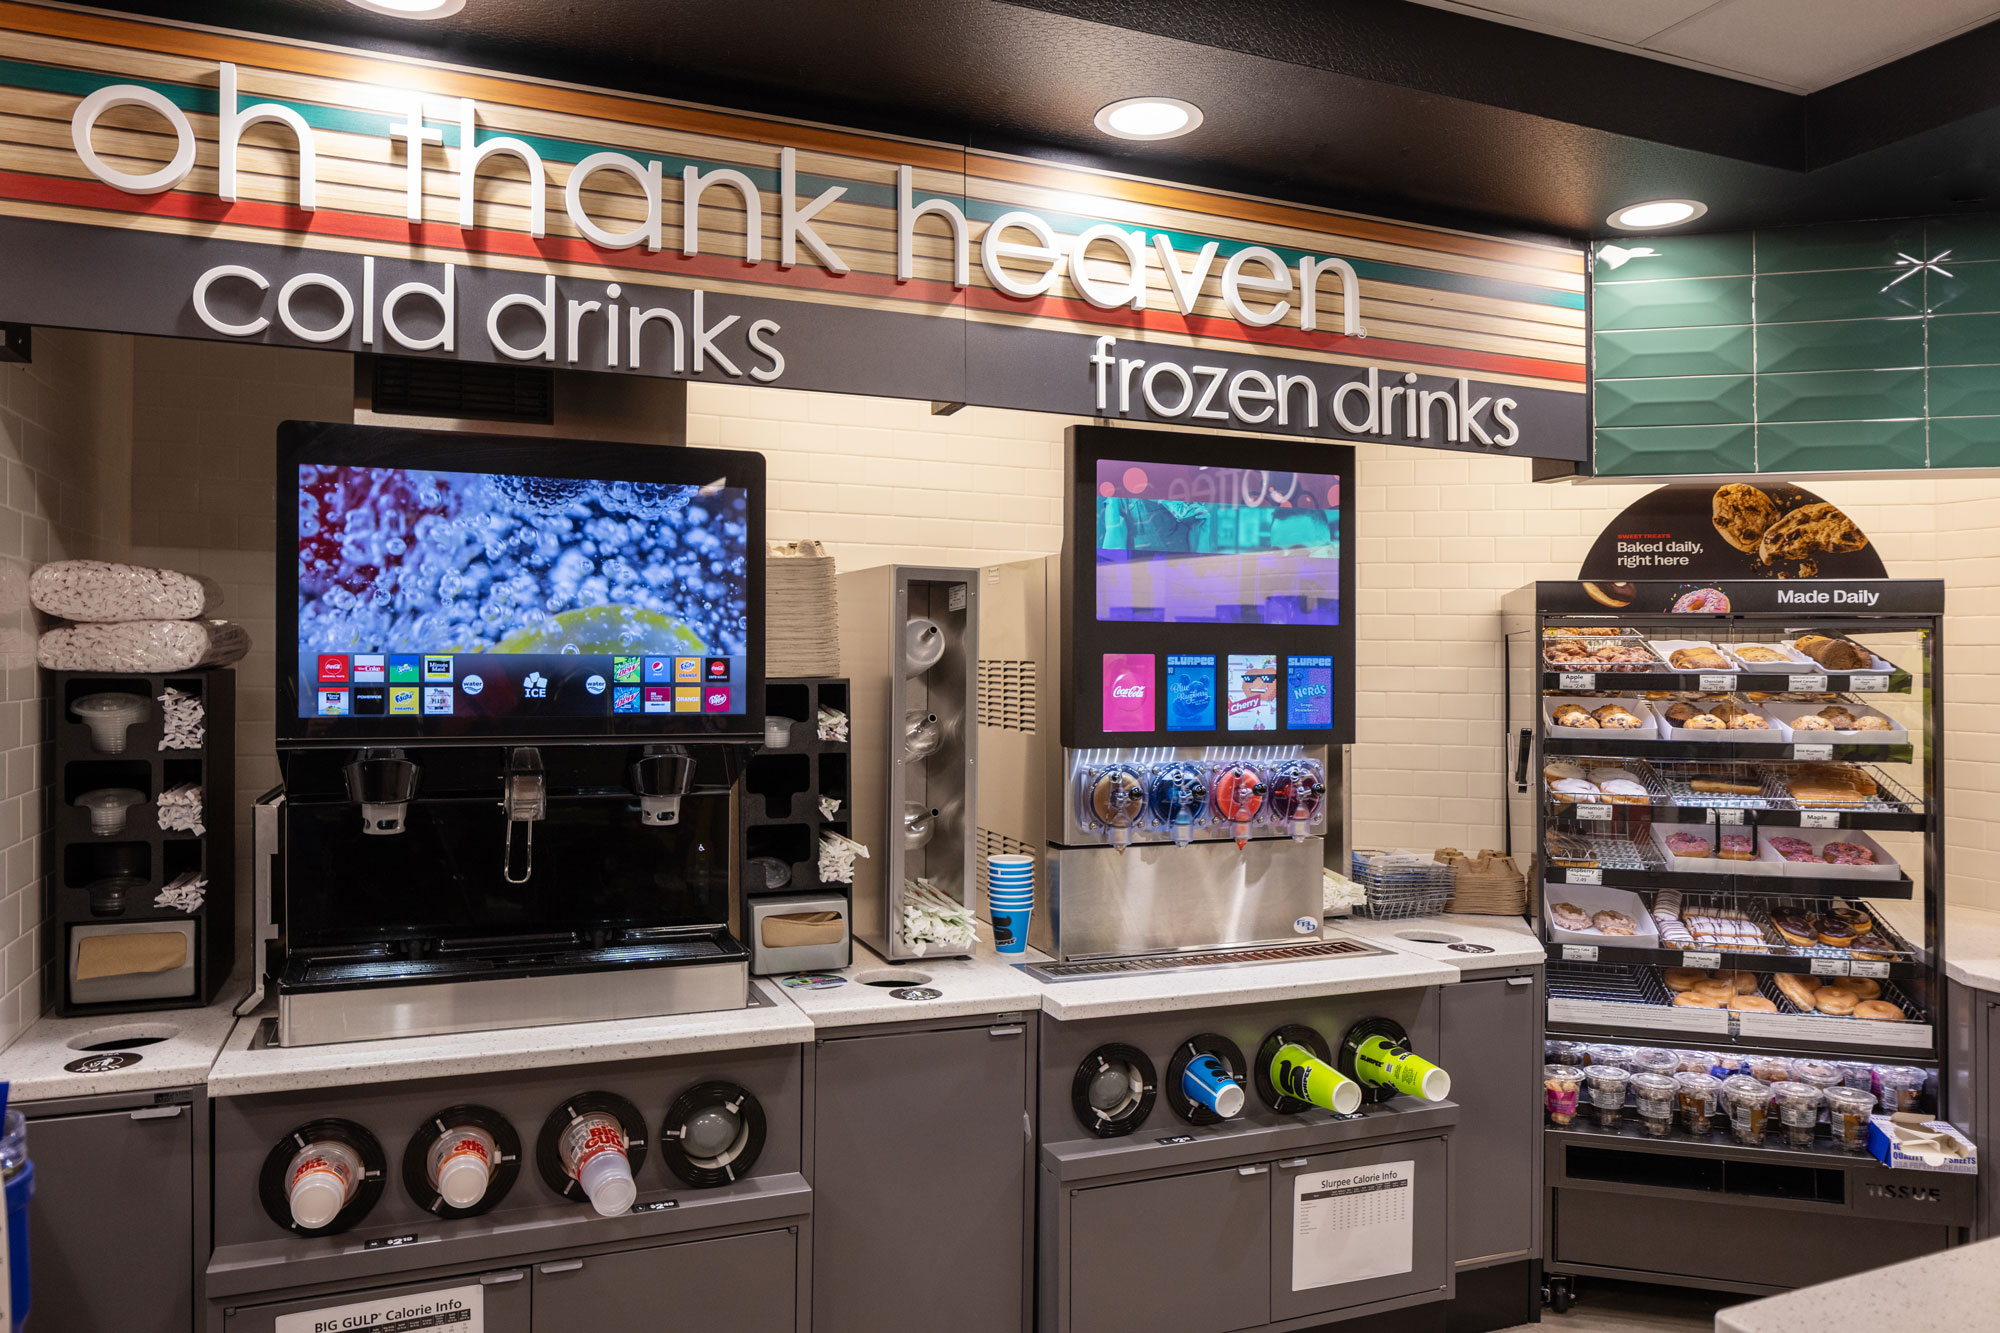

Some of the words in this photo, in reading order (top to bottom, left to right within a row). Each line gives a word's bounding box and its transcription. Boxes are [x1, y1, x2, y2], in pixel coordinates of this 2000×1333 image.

[72, 62, 316, 212] oh
[390, 98, 850, 274] thank
[193, 256, 455, 352] cold
[486, 275, 785, 382] drinks
[1090, 335, 1319, 428] frozen
[1333, 367, 1519, 448] drinks
[1617, 541, 1663, 552] Baked
[1666, 541, 1703, 554] daily,
[1617, 555, 1652, 568] right
[1654, 555, 1689, 565] here
[1777, 590, 1830, 603] Made
[1834, 590, 1880, 606] Daily
[1168, 657, 1215, 666] SLURPEE
[1288, 657, 1331, 666] SLURPEE
[525, 689, 546, 698] ICE
[1231, 698, 1261, 714] Cherry
[1360, 1054, 1385, 1068] SLURPEE
[1321, 1178, 1351, 1190] Slurpee
[1353, 1174, 1380, 1185] Calorie
[1382, 1171, 1397, 1180] Info
[1866, 1183, 1941, 1202] TISSUE
[315, 1319, 338, 1333] BIG
[386, 1303, 431, 1321] Calorie
[436, 1299, 461, 1313] Info
